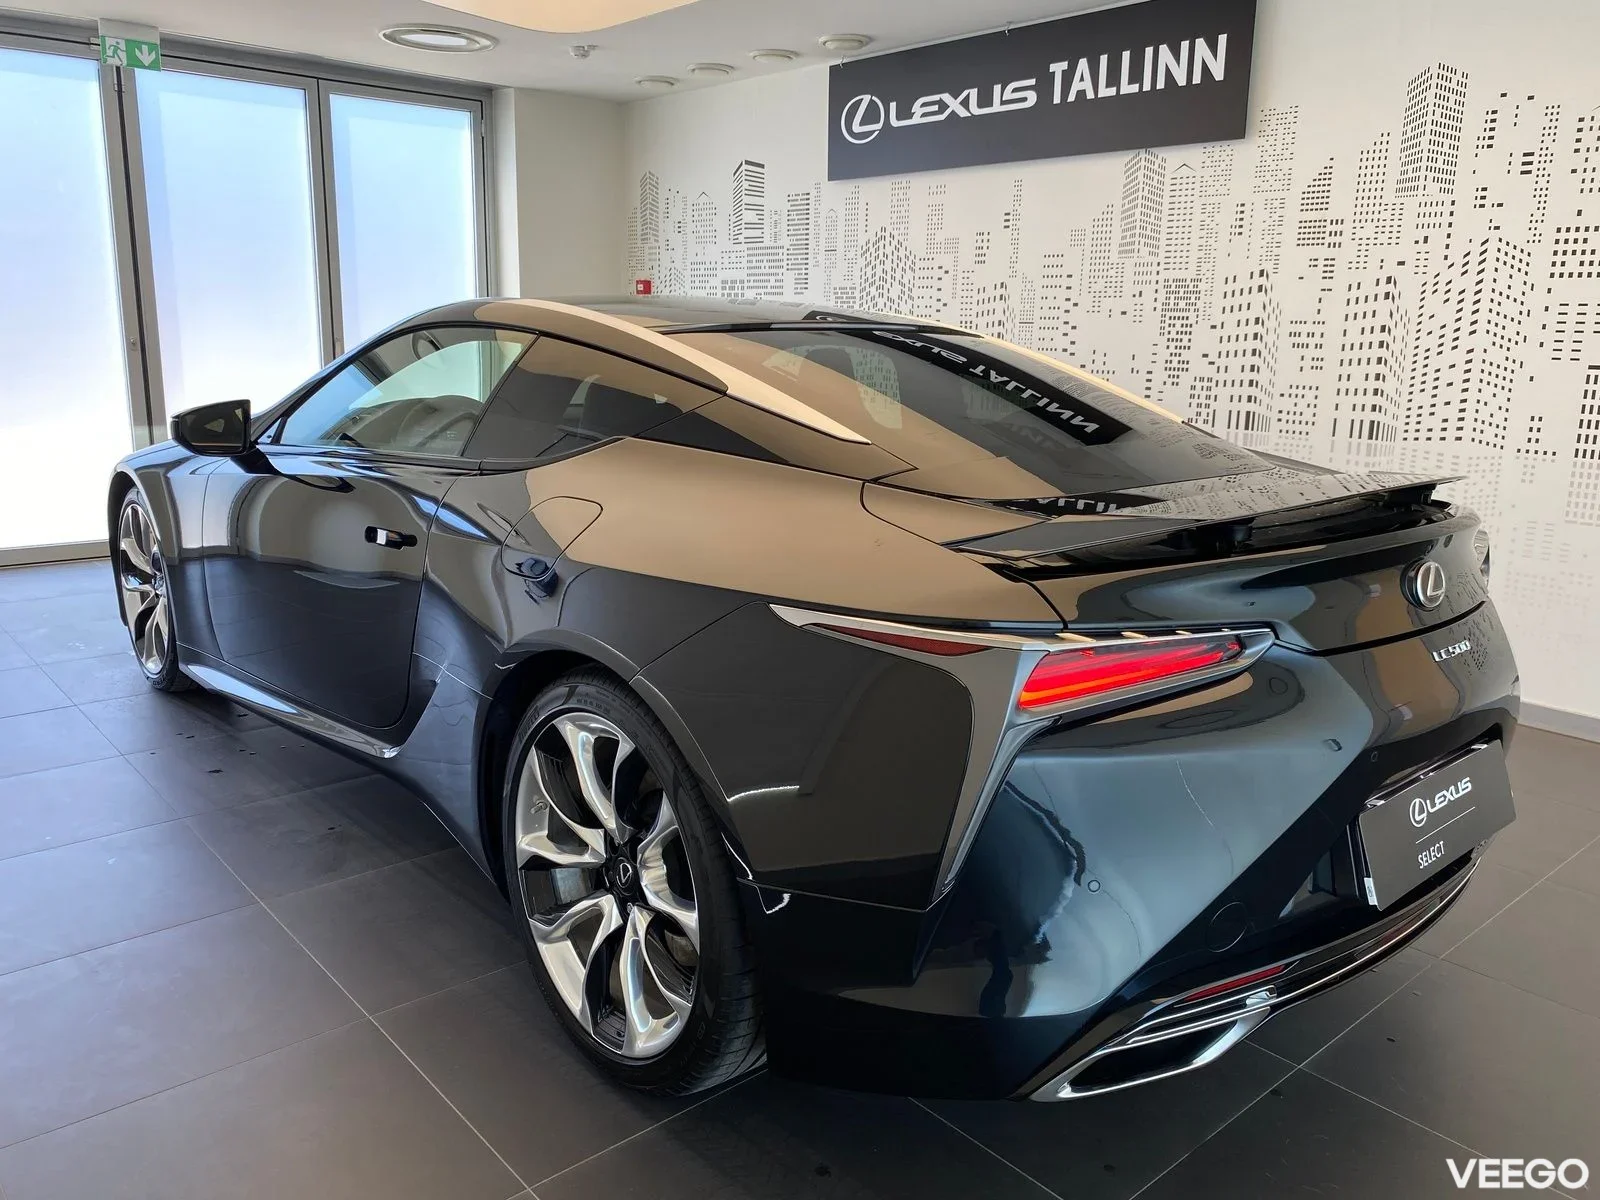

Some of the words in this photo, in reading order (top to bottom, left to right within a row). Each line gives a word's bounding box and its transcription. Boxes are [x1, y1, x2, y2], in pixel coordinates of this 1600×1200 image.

[889, 78, 1038, 128] LEXUS
[1048, 33, 1228, 105] TALLINN
[1426, 777, 1472, 813] LEXUS
[1417, 840, 1446, 869] SELECT
